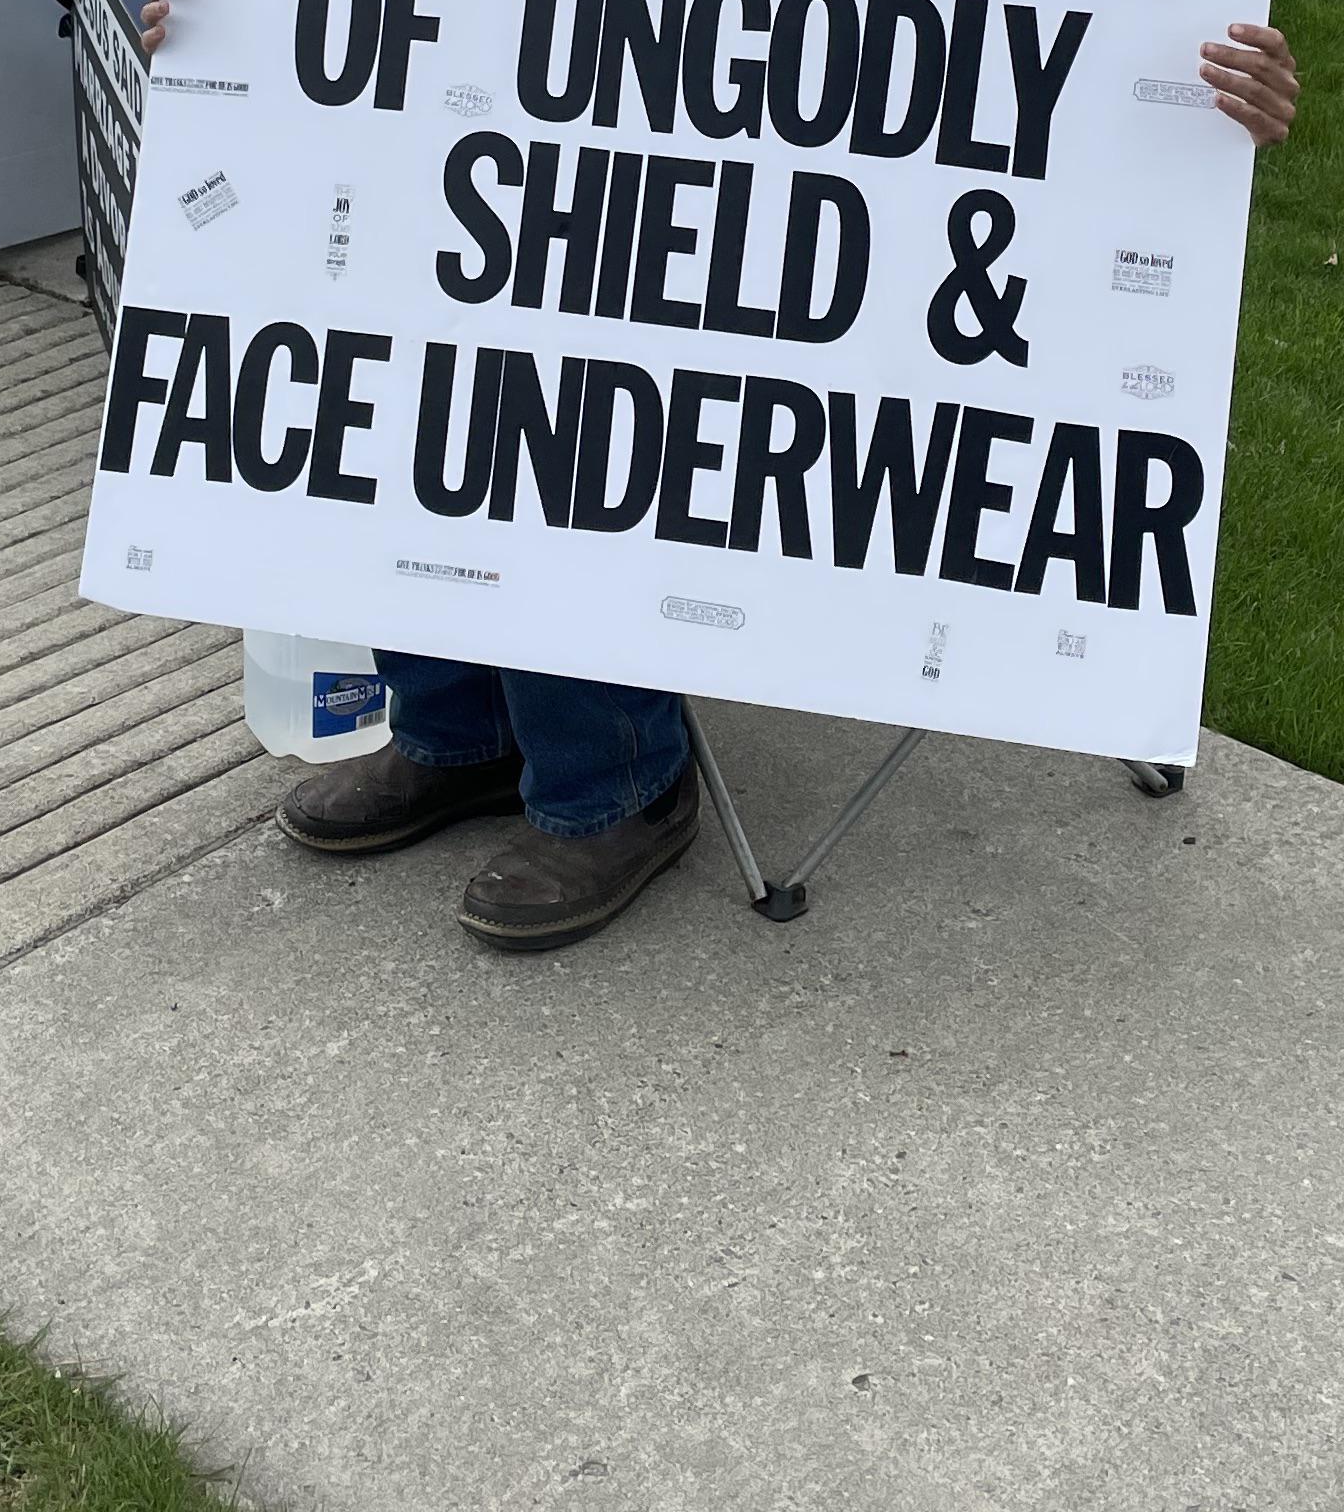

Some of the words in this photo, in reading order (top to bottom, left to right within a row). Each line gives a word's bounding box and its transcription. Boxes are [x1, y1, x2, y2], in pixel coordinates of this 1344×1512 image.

[113, 29, 143, 126] SAID
[89, 128, 126, 259] DIVOR
[435, 131, 871, 344] SHIELD
[926, 188, 1029, 368] &
[99, 305, 393, 505] FACE
[413, 341, 1205, 617] UNDERWEAR
